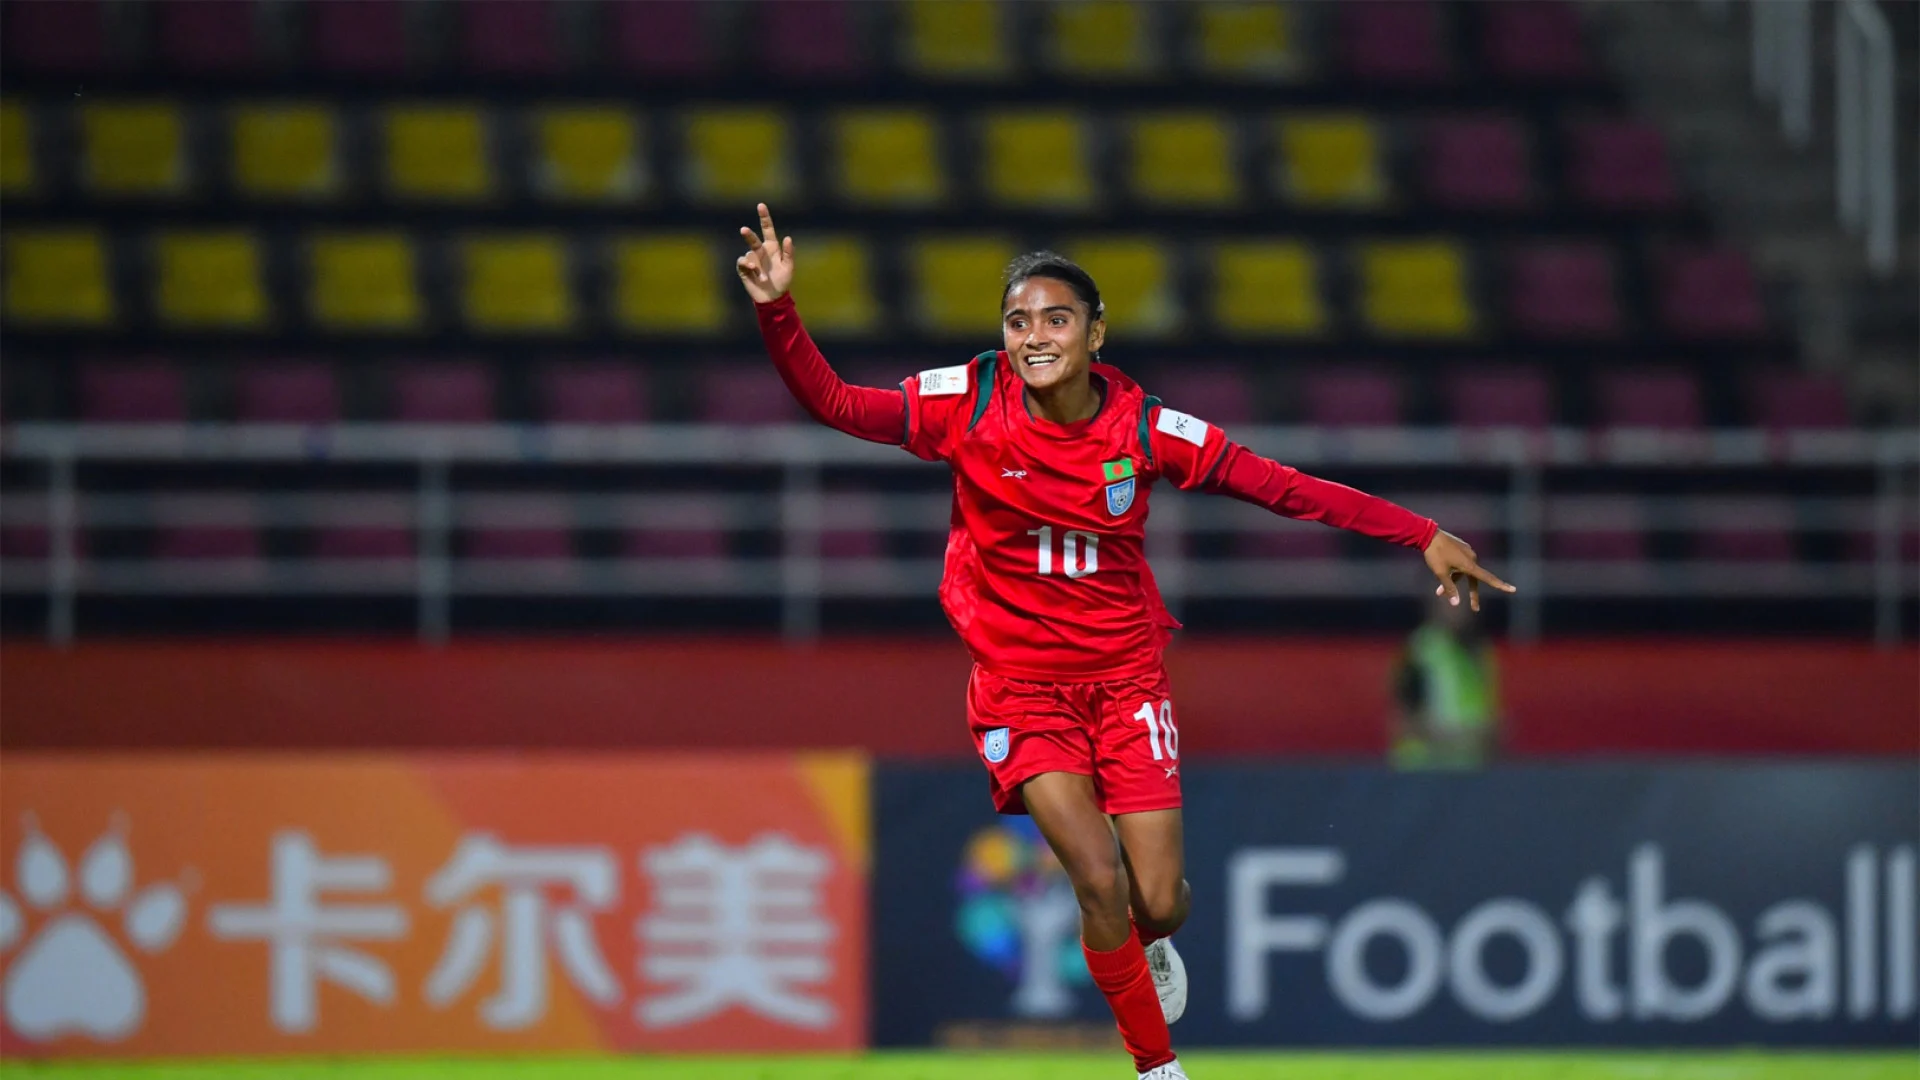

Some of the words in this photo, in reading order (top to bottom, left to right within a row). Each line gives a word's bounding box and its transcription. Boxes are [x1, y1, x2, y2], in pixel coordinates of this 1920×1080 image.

[1027, 526, 1099, 578] 10
[1133, 700, 1178, 760] 10
[210, 830, 839, 1029] 卡尔美
[1226, 845, 1917, 1020] Football
